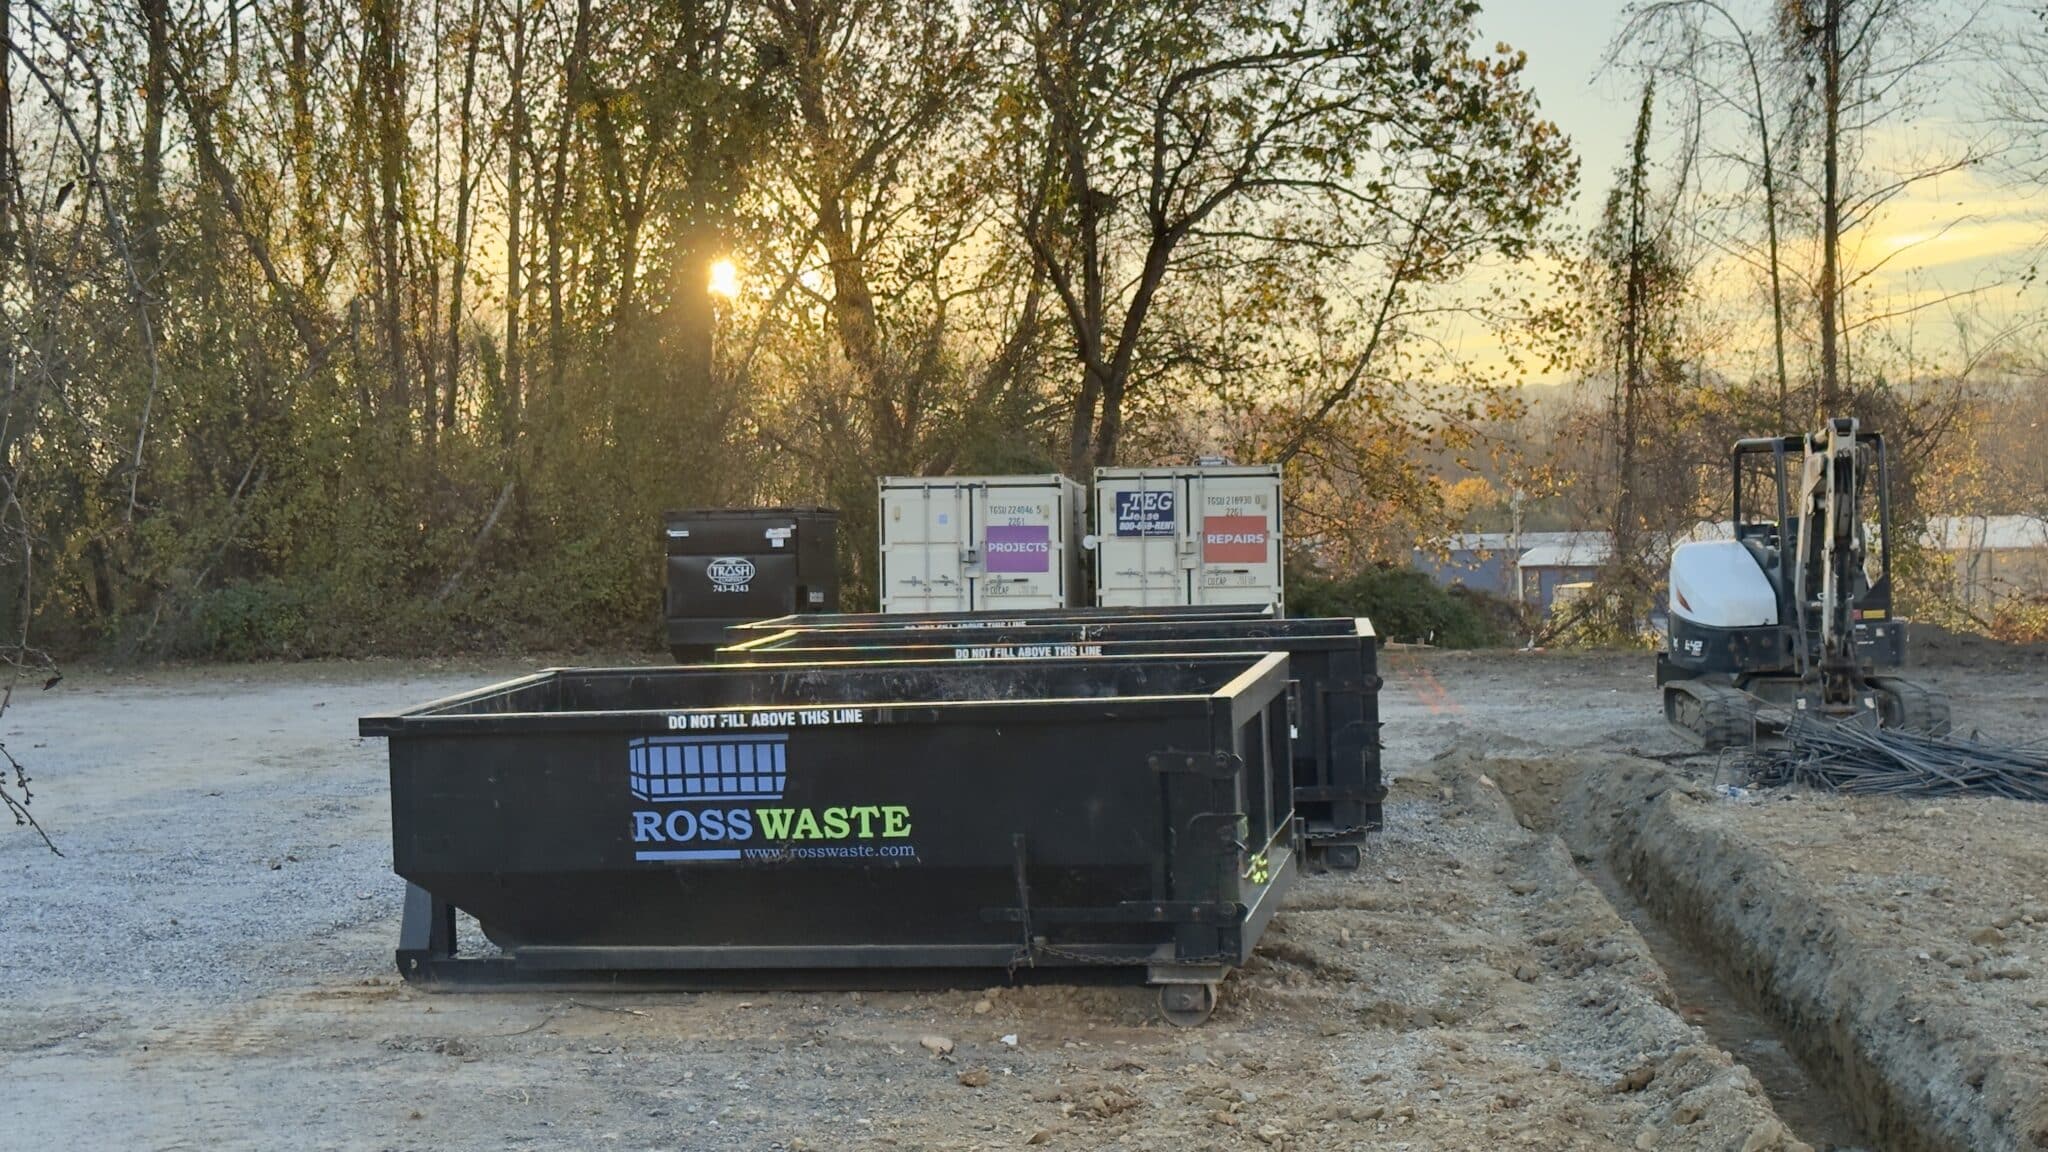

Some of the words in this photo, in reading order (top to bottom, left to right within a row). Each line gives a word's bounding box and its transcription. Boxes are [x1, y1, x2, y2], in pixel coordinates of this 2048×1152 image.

[1130, 493, 1173, 510] TEG
[990, 506, 1006, 515] TGSU
[1036, 505, 1041, 514] 5
[1207, 534, 1264, 544] REPAIRS
[988, 542, 1048, 553] PROJECTS
[711, 565, 750, 576] TRASH
[712, 584, 749, 593] 743-4243
[955, 649, 970, 659] DO
[972, 648, 992, 658] NOT
[994, 648, 1015, 658] FILL
[1017, 647, 1052, 657] ABOVE
[1054, 646, 1078, 656] THIS
[1079, 645, 1103, 656] LINE
[668, 716, 687, 729] DO
[690, 715, 717, 728] NOT
[720, 714, 748, 728] FILL
[751, 712, 796, 727] ABOVE
[799, 711, 830, 725] THIS
[833, 709, 864, 724] LINE
[632, 809, 753, 842] ROSS
[756, 806, 912, 840] WASTE
[744, 844, 916, 860] wwwrosswaste.com
